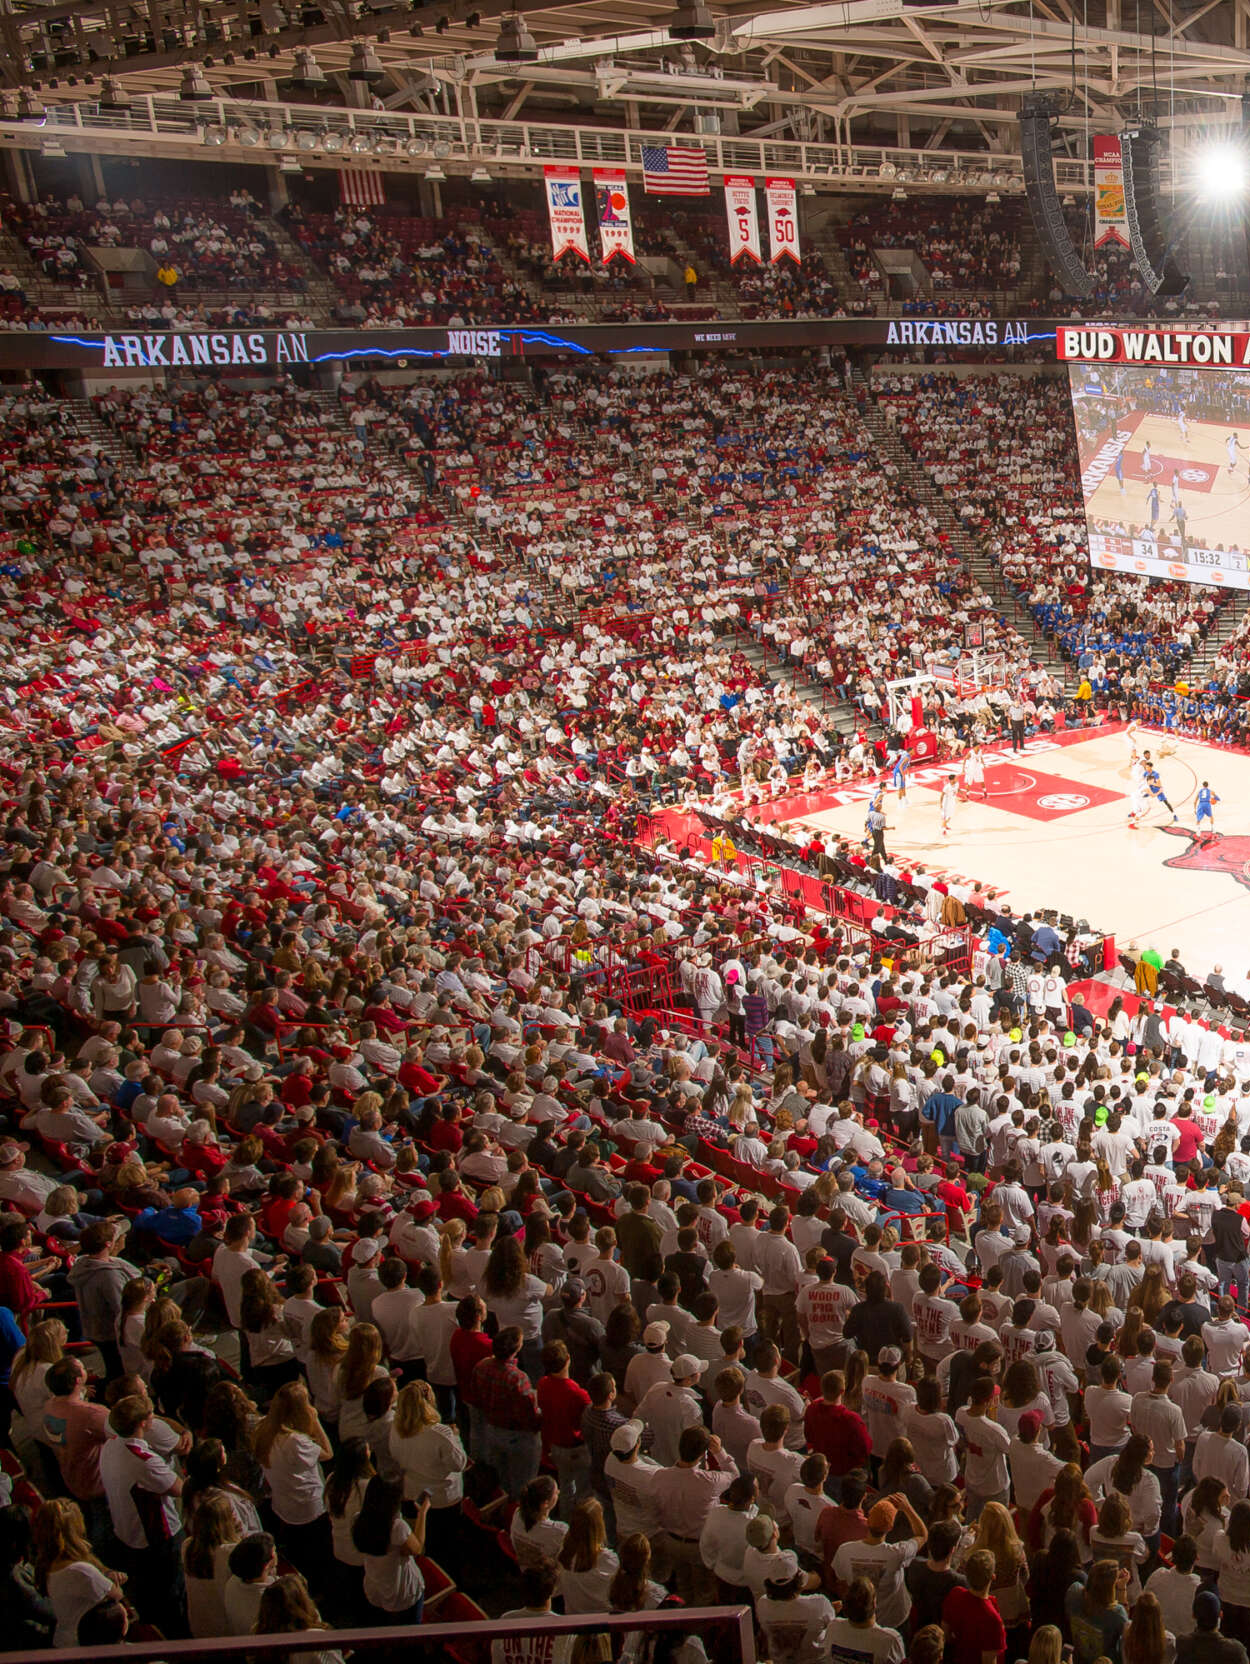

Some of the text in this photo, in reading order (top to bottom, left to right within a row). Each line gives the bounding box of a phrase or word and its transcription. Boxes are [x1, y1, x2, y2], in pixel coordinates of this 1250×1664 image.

[738, 219, 750, 242] 5
[775, 219, 795, 243] 50
[886, 322, 1029, 345] ARKANSAS AN
[103, 333, 310, 367] ARKANSAS AN
[447, 331, 501, 356] NOISE
[1064, 330, 1115, 359] BUD
[1122, 333, 1233, 364] WALTON
[1141, 543, 1154, 556] 34
[1193, 551, 1222, 567] 15:32
[1235, 560, 1242, 570] 2
[1207, 1117, 1217, 1127] THE
[813, 1303, 833, 1313] PIG
[925, 1307, 944, 1322] THE
[963, 1335, 980, 1349] THE
[1014, 1336, 1032, 1350] THE
[528, 1635, 553, 1658] THE
